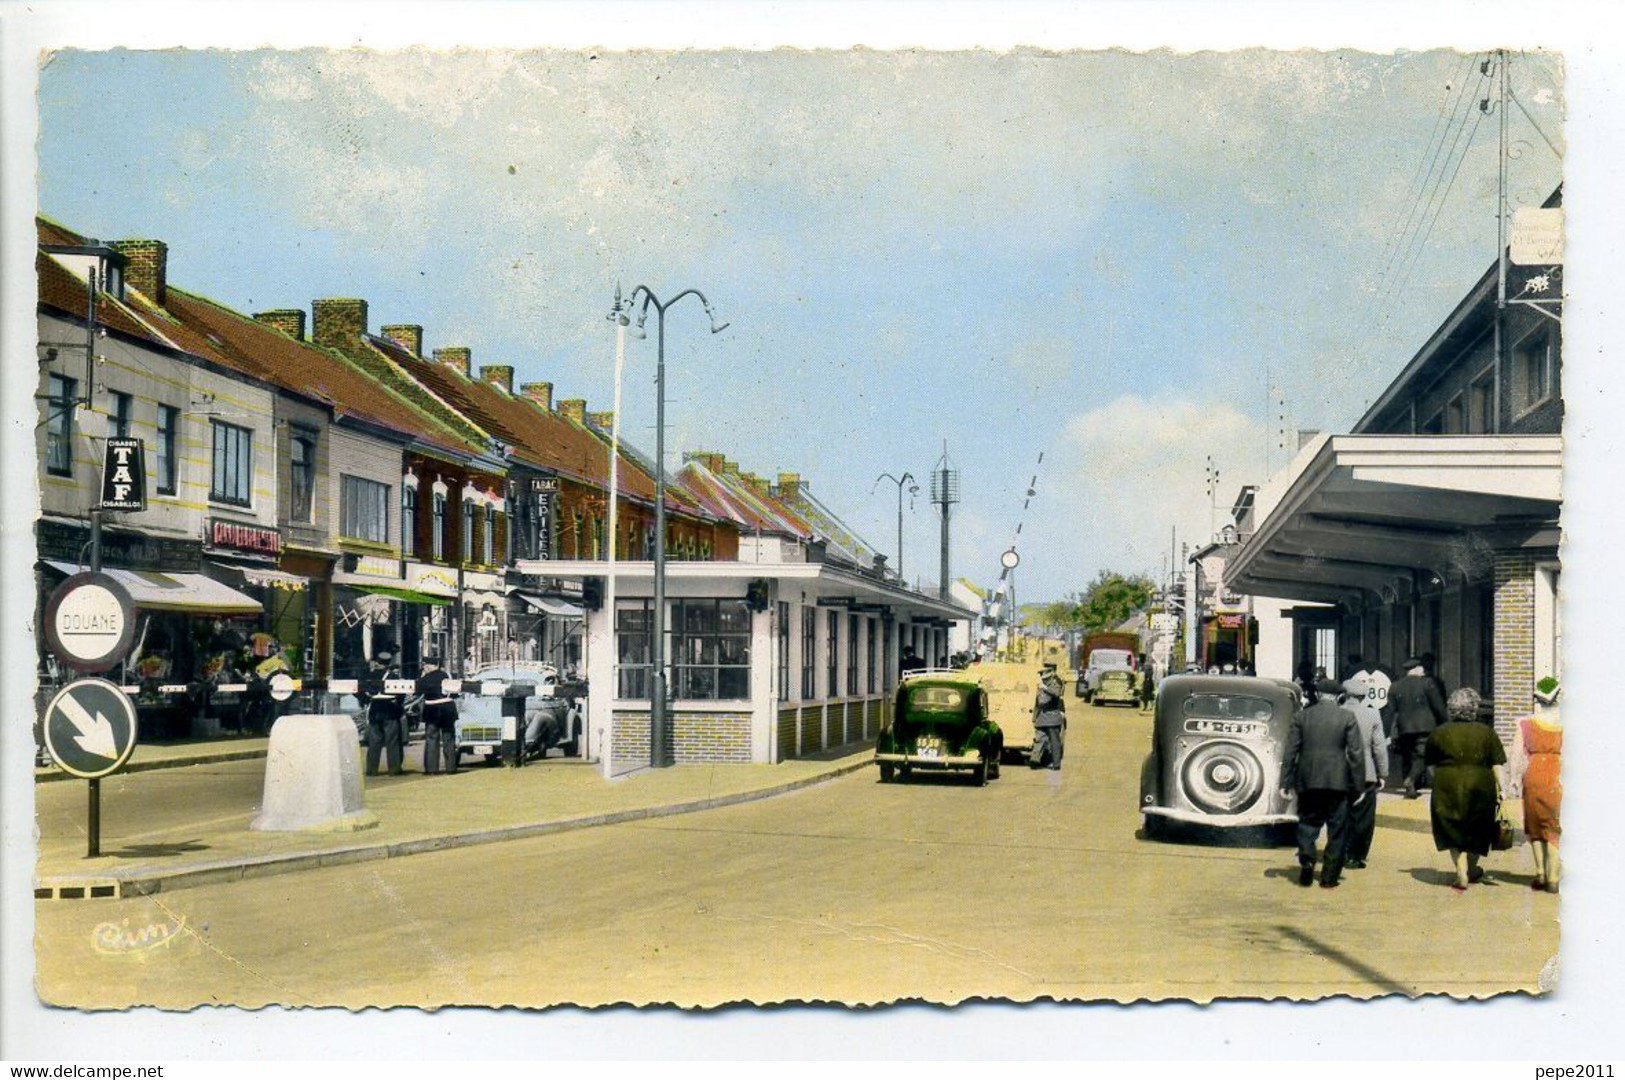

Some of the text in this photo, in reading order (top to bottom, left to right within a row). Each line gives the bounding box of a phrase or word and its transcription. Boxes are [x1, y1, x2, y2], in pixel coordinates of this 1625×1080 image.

[112, 448, 132, 500] TAF
[531, 480, 557, 490] TABAC
[63, 614, 117, 630] DOUANE
[1368, 687, 1387, 700] 80
